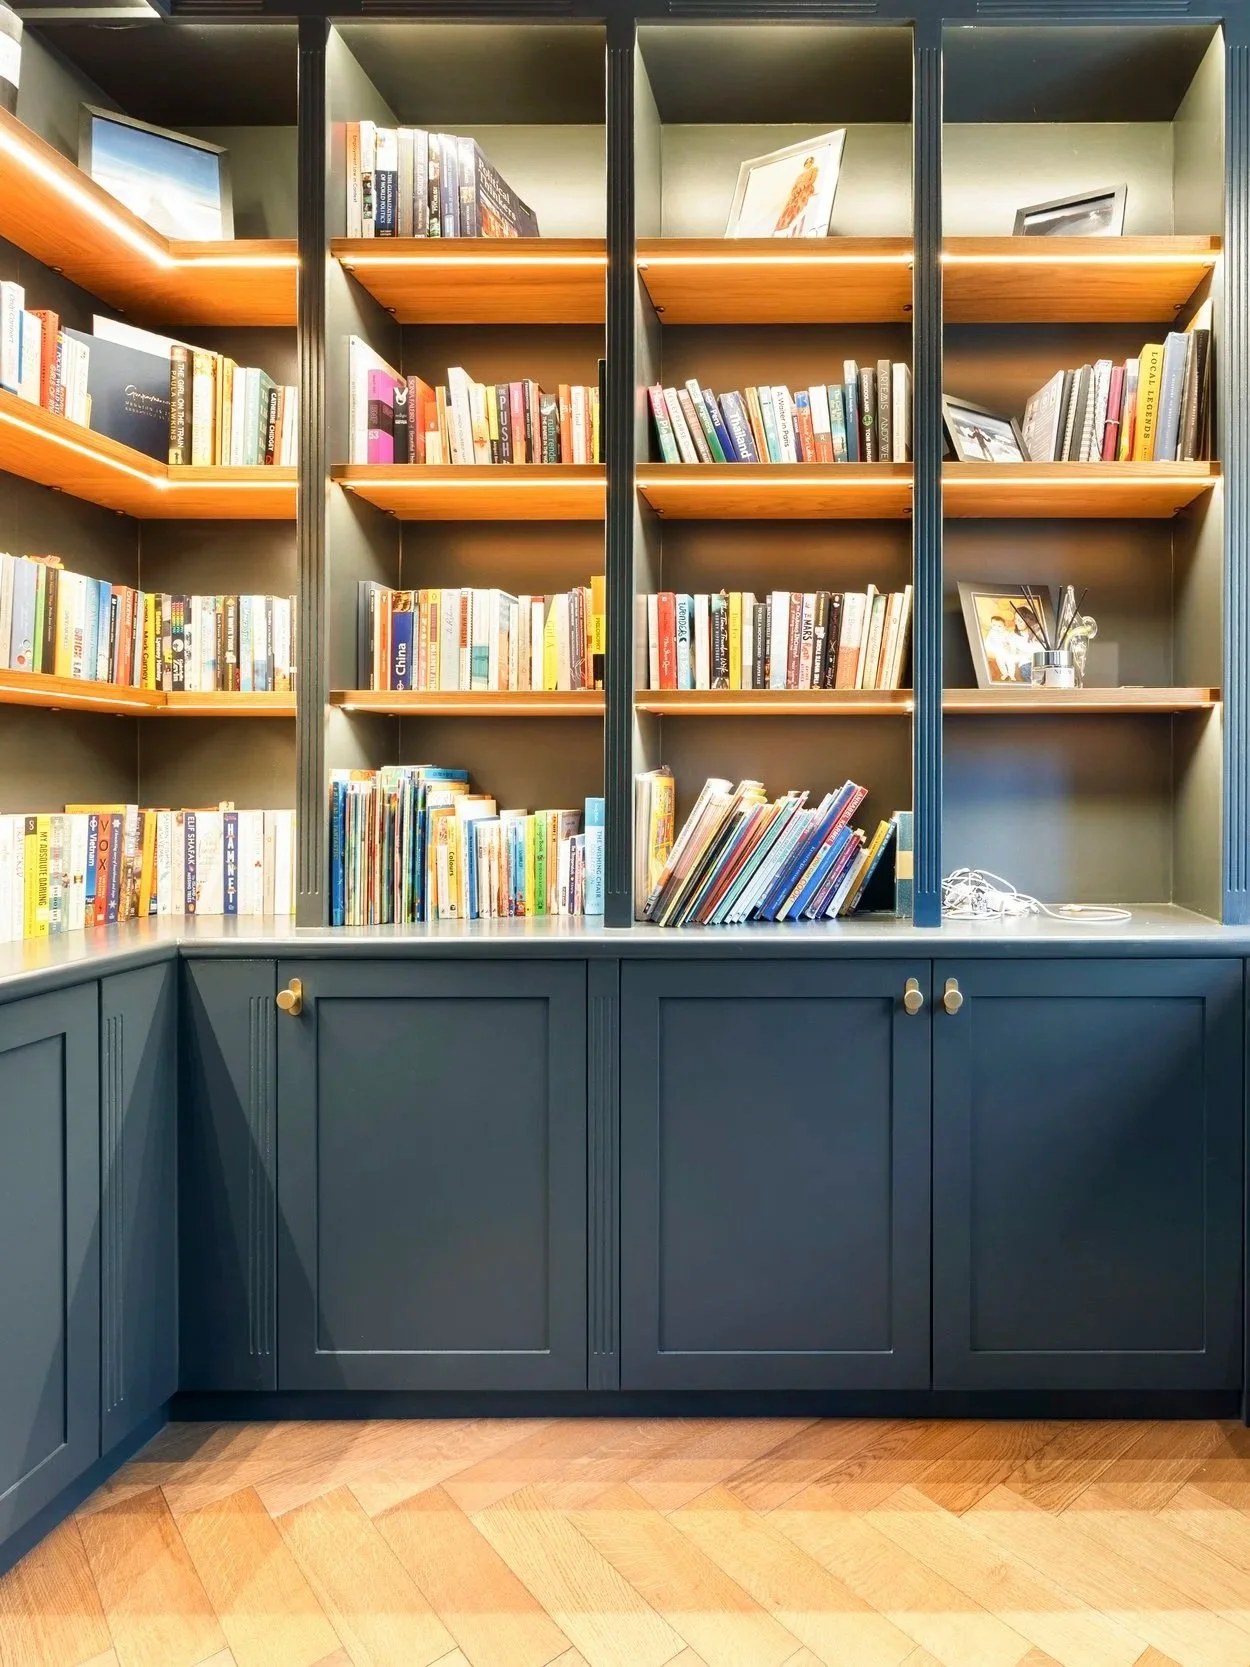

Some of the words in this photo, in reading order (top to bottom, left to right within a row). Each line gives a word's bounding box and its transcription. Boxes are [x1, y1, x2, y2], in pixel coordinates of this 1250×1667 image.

[478, 158, 510, 204] Political
[478, 170, 516, 220] Thinkers
[1148, 352, 1158, 386] LOCAL
[178, 398, 184, 409] ON
[654, 390, 664, 419] Happy
[711, 409, 721, 426] Peru
[1144, 390, 1154, 439] LEGENDS
[500, 396, 509, 456] PUSH
[699, 406, 712, 434] Argentina
[730, 412, 751, 458] Thailand
[74, 628, 82, 659] BRICK
[803, 620, 812, 641] MARS
[395, 643, 406, 676] China
[716, 658, 728, 674] Wife
[845, 792, 863, 819] ANNABEL
[40, 832, 47, 841] MY
[829, 820, 846, 842] KARMEL
[99, 820, 109, 871] VOX
[39, 844, 47, 876] ABSOLUTE
[812, 856, 821, 867] you
[38, 878, 47, 906] DARLING
[789, 879, 807, 903] COOK!
